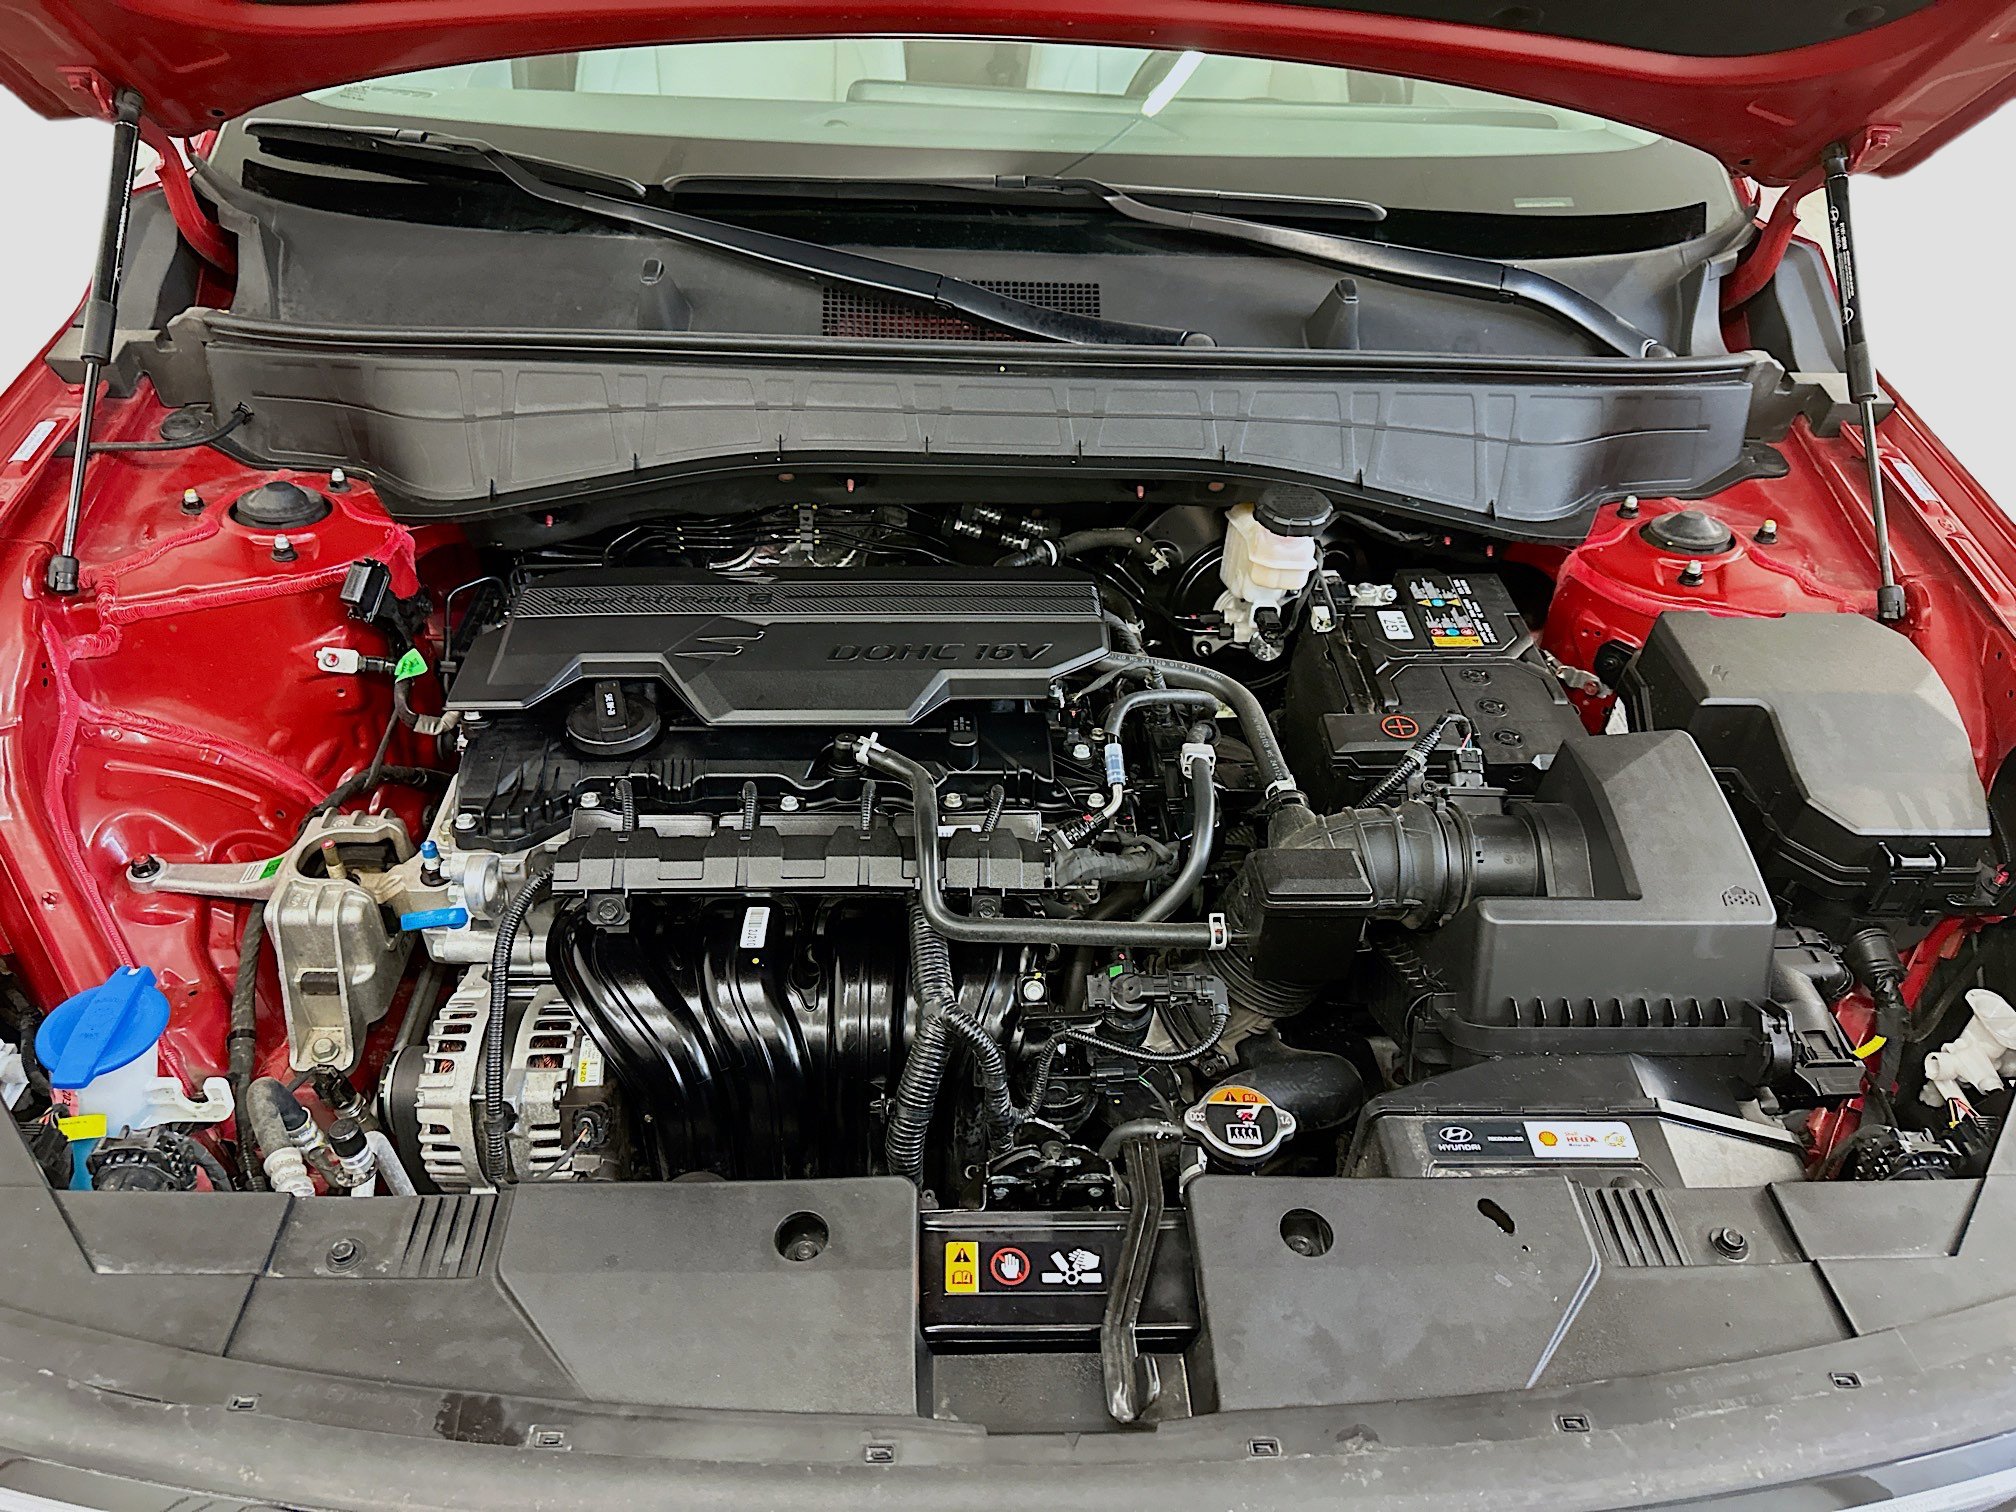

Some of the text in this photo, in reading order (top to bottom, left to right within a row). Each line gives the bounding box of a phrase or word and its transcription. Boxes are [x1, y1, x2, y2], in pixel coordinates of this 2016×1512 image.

[544, 593, 740, 607] Smartstream
[826, 642, 1054, 663] DOHC 16V
[1566, 1135, 1598, 1143] HELIX
[1438, 1143, 1482, 1151] HYUNDAI
